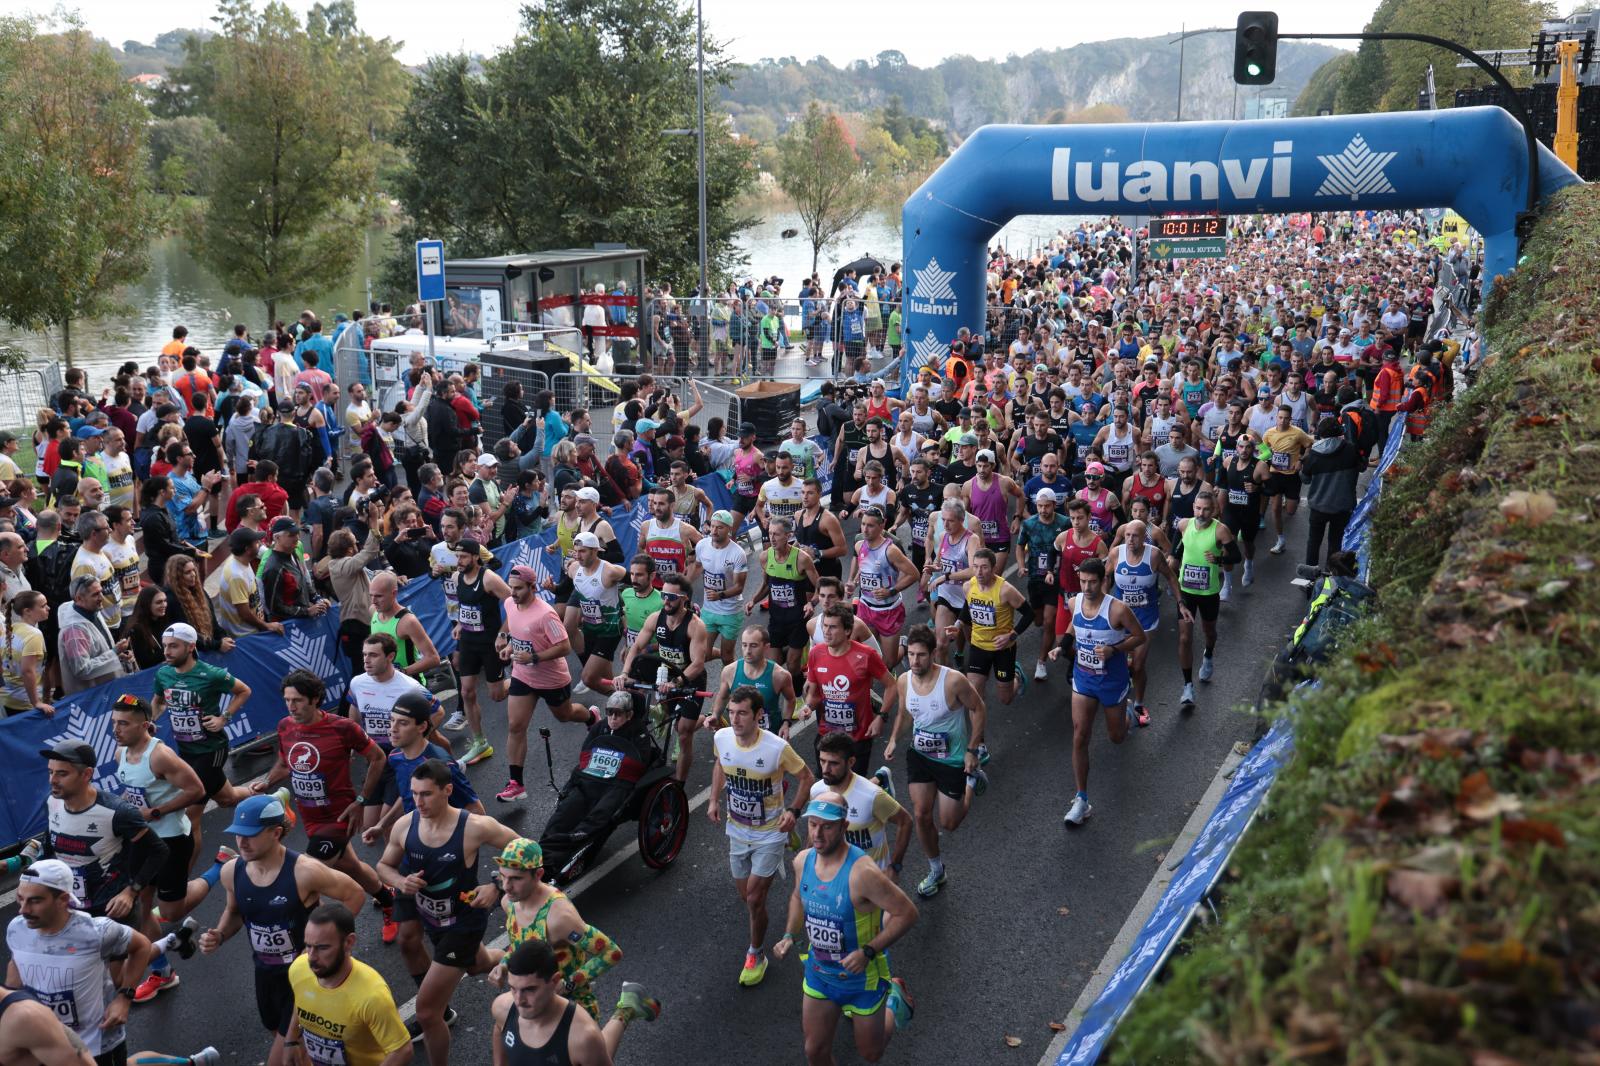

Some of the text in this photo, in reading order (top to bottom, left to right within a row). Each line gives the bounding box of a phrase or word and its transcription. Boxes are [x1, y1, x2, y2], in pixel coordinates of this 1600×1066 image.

[1051, 140, 1293, 202] luanvi
[1162, 221, 1218, 235] 10:01:12
[910, 298, 958, 316] luanvi
[1040, 557, 1047, 565] 7
[655, 564, 673, 572] 701
[704, 574, 722, 587] 1321
[1185, 571, 1207, 580] 1019
[861, 577, 878, 587] 976
[772, 588, 793, 598] 1212
[1125, 594, 1145, 603] 569
[461, 610, 478, 619] 586
[972, 610, 990, 621] 931
[661, 650, 681, 660] 364
[1079, 652, 1100, 665] 508
[825, 708, 853, 720] 1318
[173, 716, 196, 728] 576
[368, 719, 392, 729] 555
[917, 736, 942, 747] 566
[593, 753, 618, 768] 1660
[736, 767, 747, 777] 59
[292, 779, 322, 792] 1099
[726, 773, 773, 792] HOBIA
[732, 798, 757, 812] 507
[419, 896, 447, 912] 735
[808, 900, 830, 911] ESTATE
[254, 931, 285, 947] 736
[807, 924, 839, 944] 1209
[296, 1006, 347, 1035] TRIBOOST
[305, 1041, 336, 1059] 577
